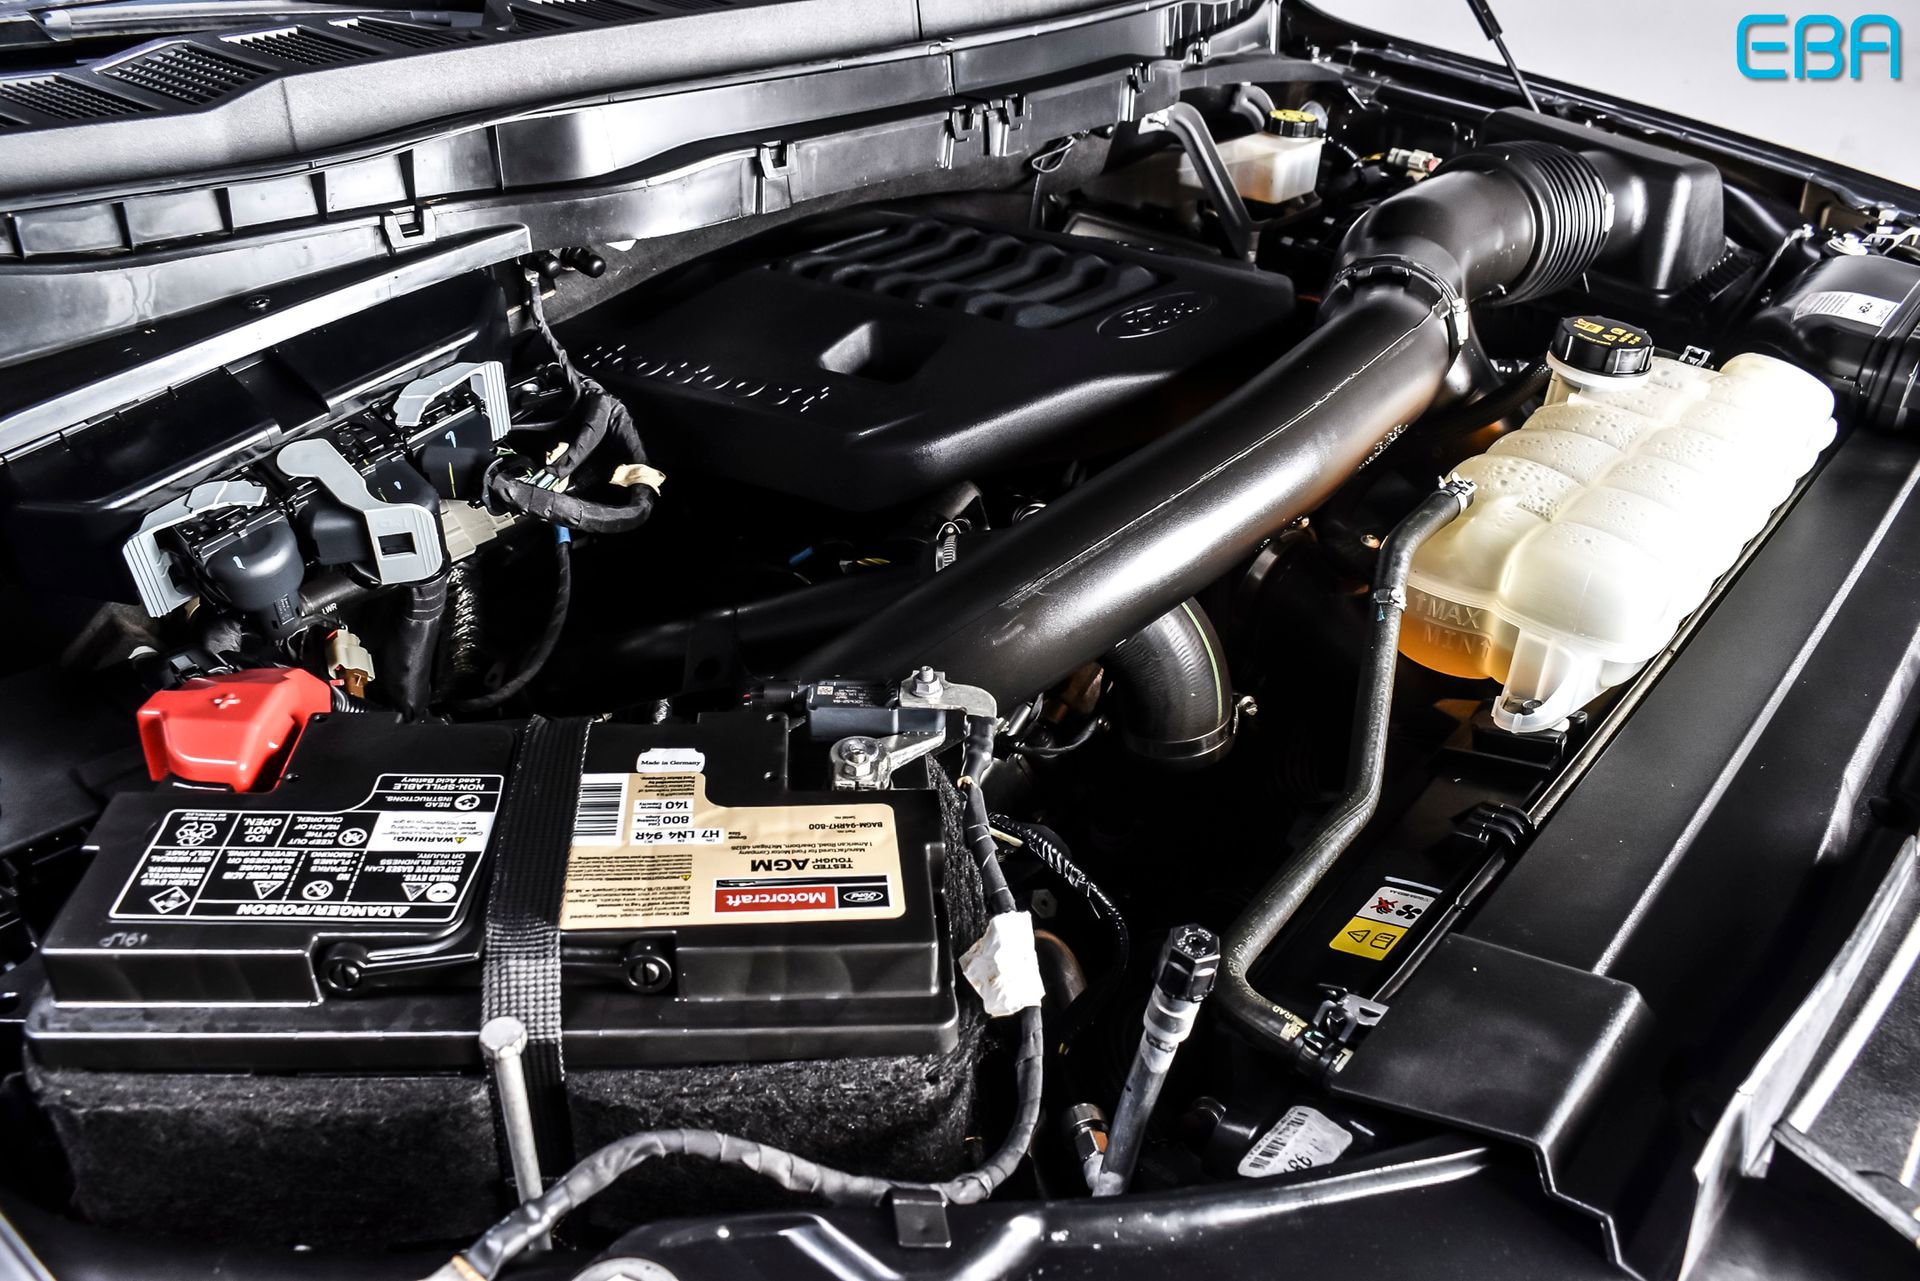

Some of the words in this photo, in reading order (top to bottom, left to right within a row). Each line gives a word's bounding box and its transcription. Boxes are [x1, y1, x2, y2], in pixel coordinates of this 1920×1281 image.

[1426, 600, 1481, 629] MAX
[665, 801, 688, 810] 140
[243, 818, 282, 826] OPEN.
[662, 815, 689, 824] 800
[808, 822, 883, 830] BAGM-94RH7-800
[244, 827, 274, 835] NOT
[668, 830, 695, 839] LN4
[701, 830, 720, 838] H7
[635, 832, 663, 840] 94R
[750, 859, 810, 872] AGM
[726, 892, 826, 906] Motorcraft
[236, 904, 393, 917] DANGER/POISON
